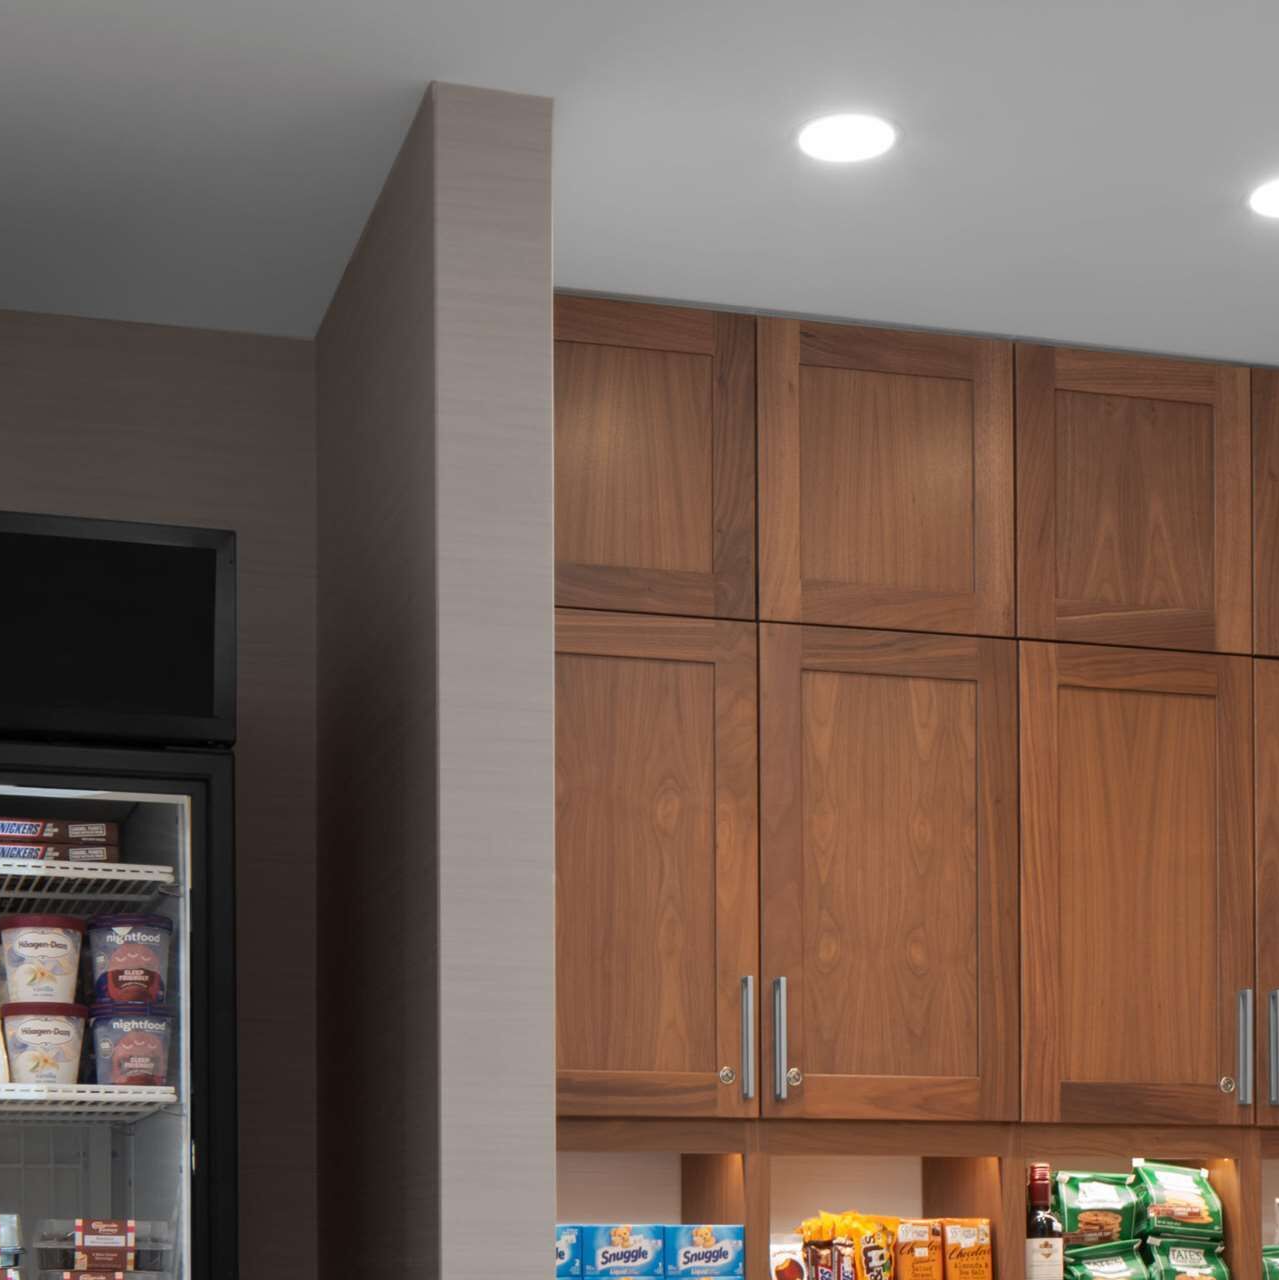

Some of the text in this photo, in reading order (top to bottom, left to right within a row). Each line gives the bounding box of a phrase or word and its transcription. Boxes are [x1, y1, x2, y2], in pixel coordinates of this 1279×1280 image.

[113, 1018, 166, 1032] nightfood
[601, 1247, 648, 1266] Snuggle
[683, 1246, 729, 1265] Snuggle
